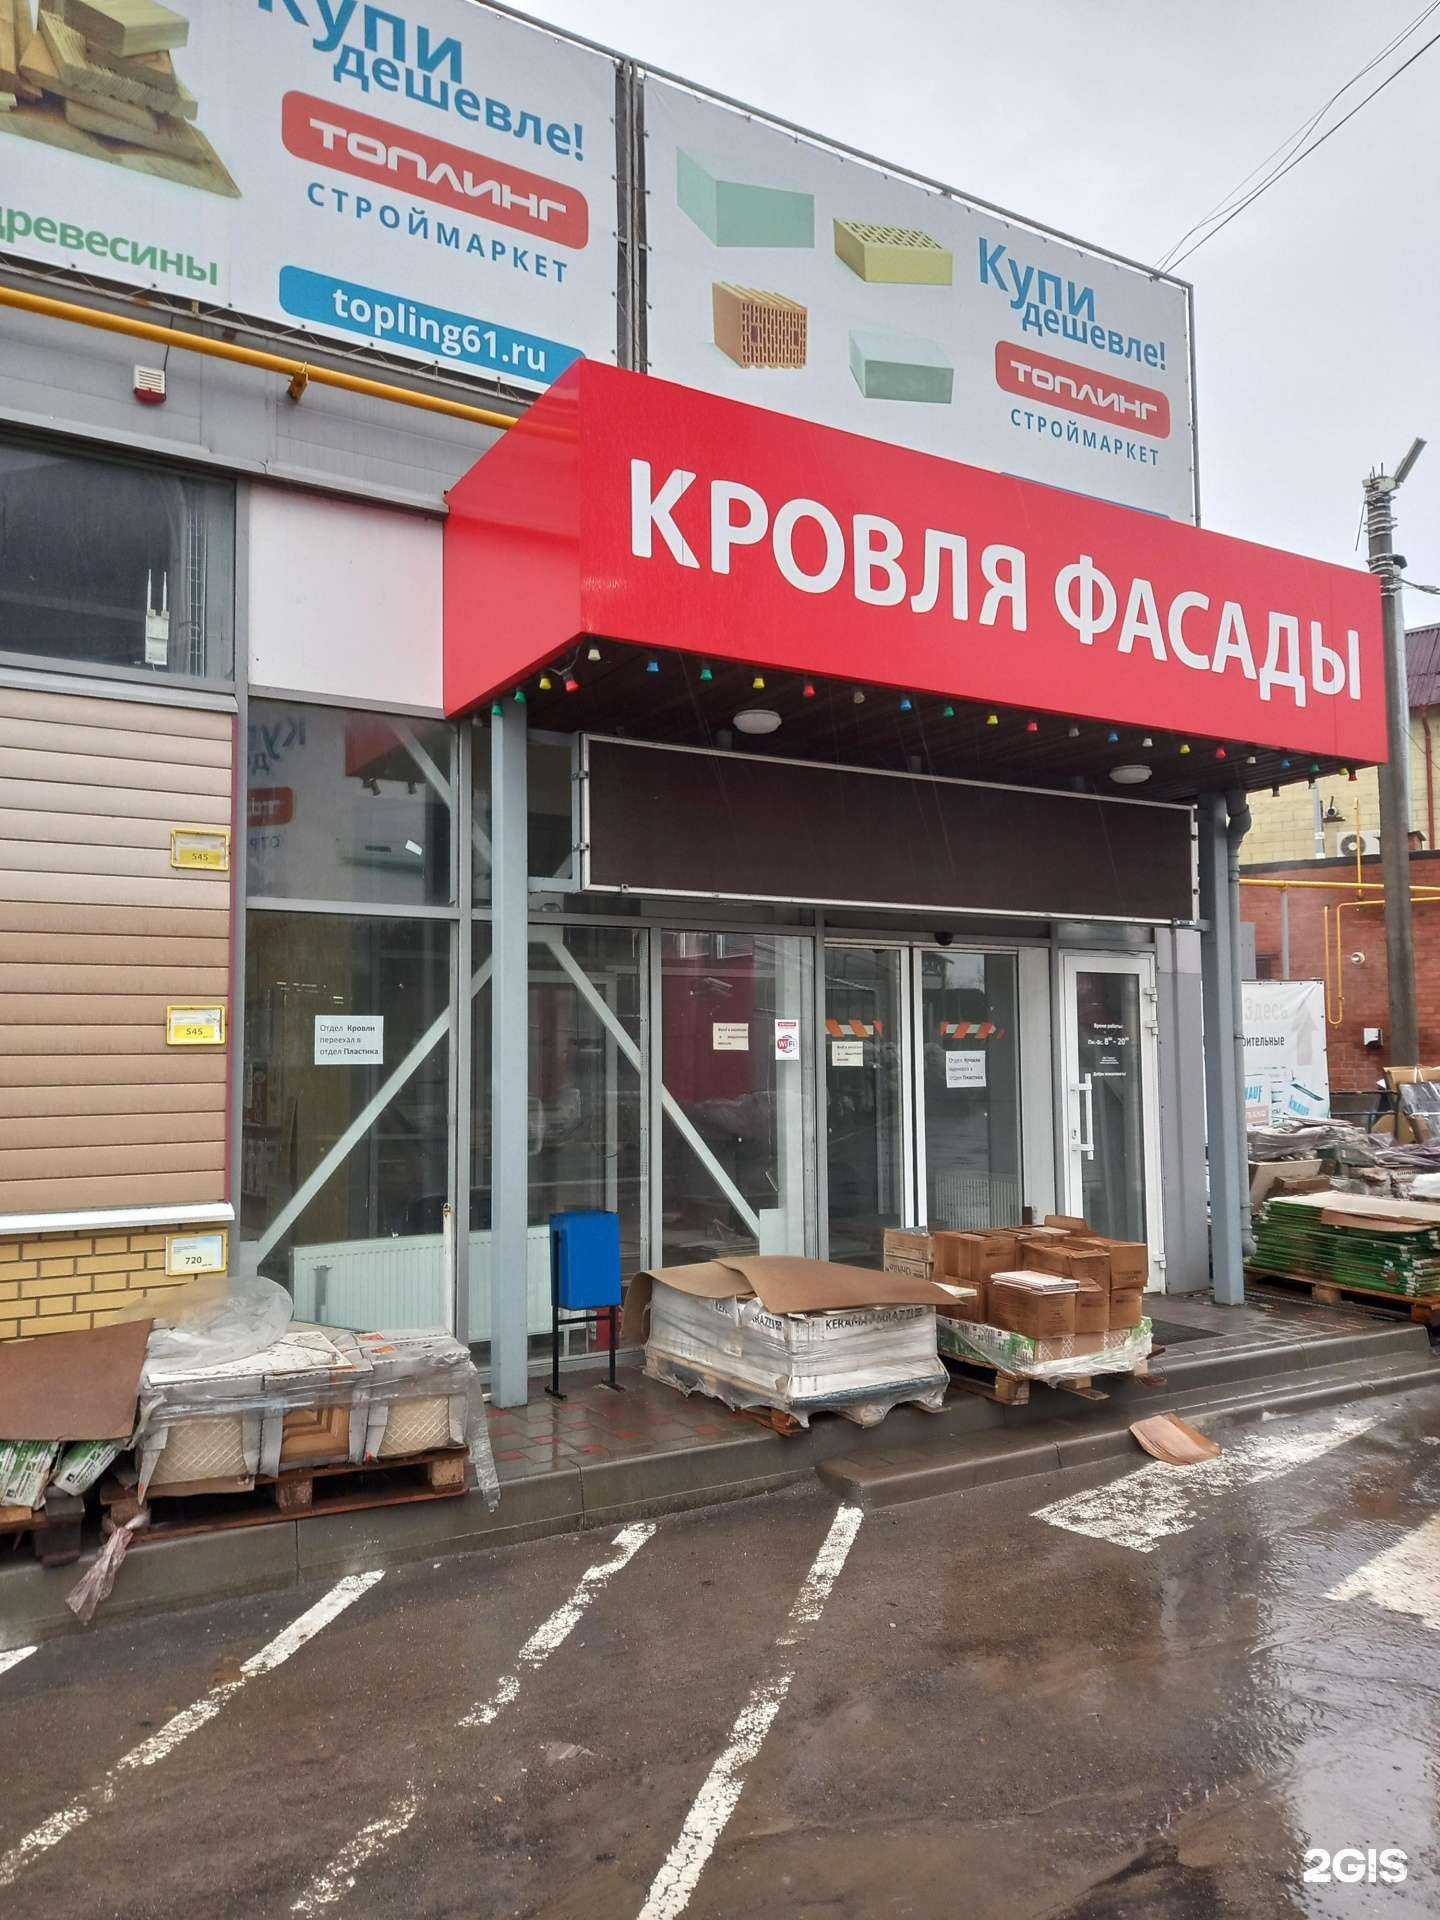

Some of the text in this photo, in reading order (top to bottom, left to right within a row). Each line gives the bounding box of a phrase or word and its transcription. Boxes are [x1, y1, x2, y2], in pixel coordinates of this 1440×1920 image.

[333, 44, 584, 161] дешевле!
[309, 117, 567, 222] ТОПЛИНГ
[307, 182, 568, 283] СТРОЙМАРКЕТ
[978, 236, 1096, 322] Купи
[333, 288, 547, 372] topling61.ru
[1022, 301, 1166, 371] дешевле!
[1010, 360, 1158, 421] ТОПЛИНГ
[1010, 408, 1159, 466] СТРОЙМАРКЕТ
[630, 458, 1361, 708] КРОВЛЯ ФАСАДЫ
[186, 1027, 203, 1036] 545
[320, 1024, 376, 1033] Отдел Кровли
[185, 1256, 203, 1265] 720
